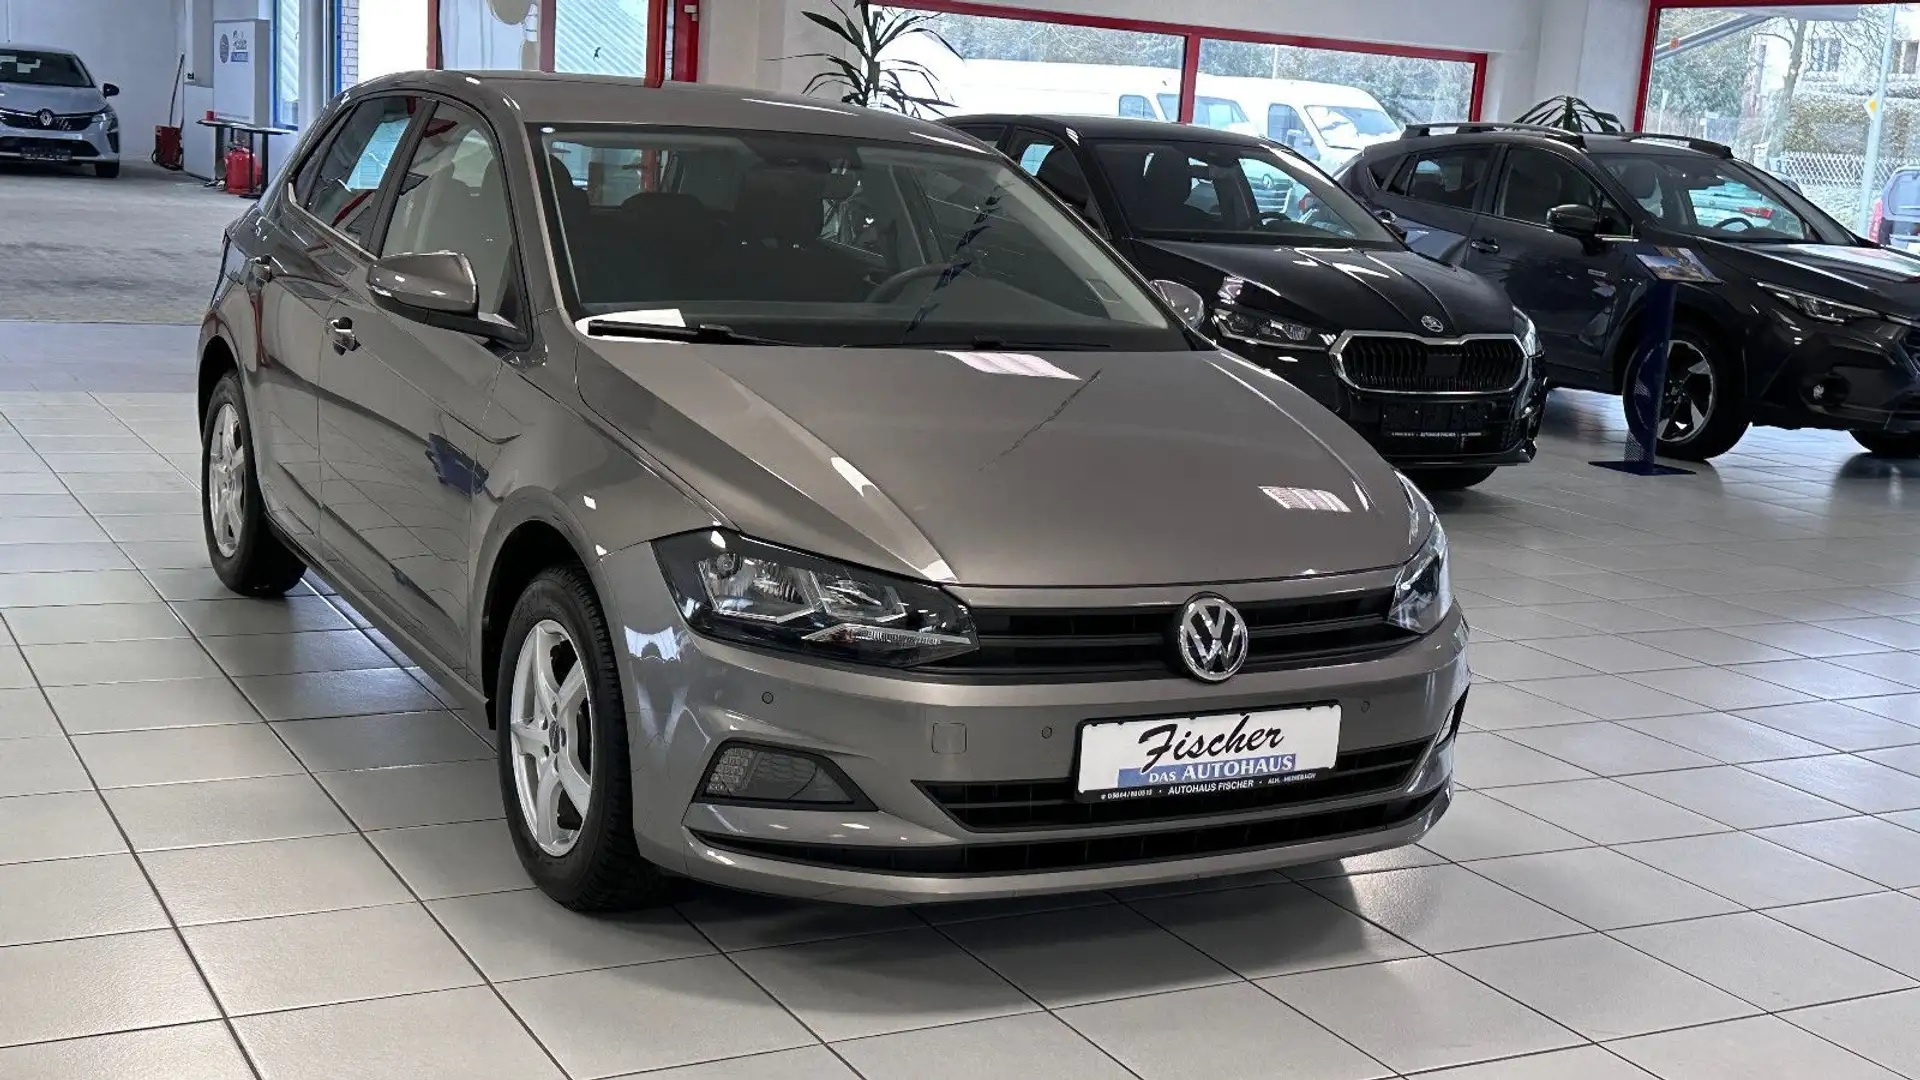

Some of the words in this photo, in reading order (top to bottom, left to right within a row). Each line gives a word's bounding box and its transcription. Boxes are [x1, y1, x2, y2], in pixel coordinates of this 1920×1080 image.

[1138, 715, 1284, 773] Fischer
[1149, 771, 1176, 783] DAS
[1182, 756, 1293, 780] AUTOHAUS
[1168, 782, 1216, 795] AUTOHAUS
[1217, 779, 1254, 791] FISCHER
